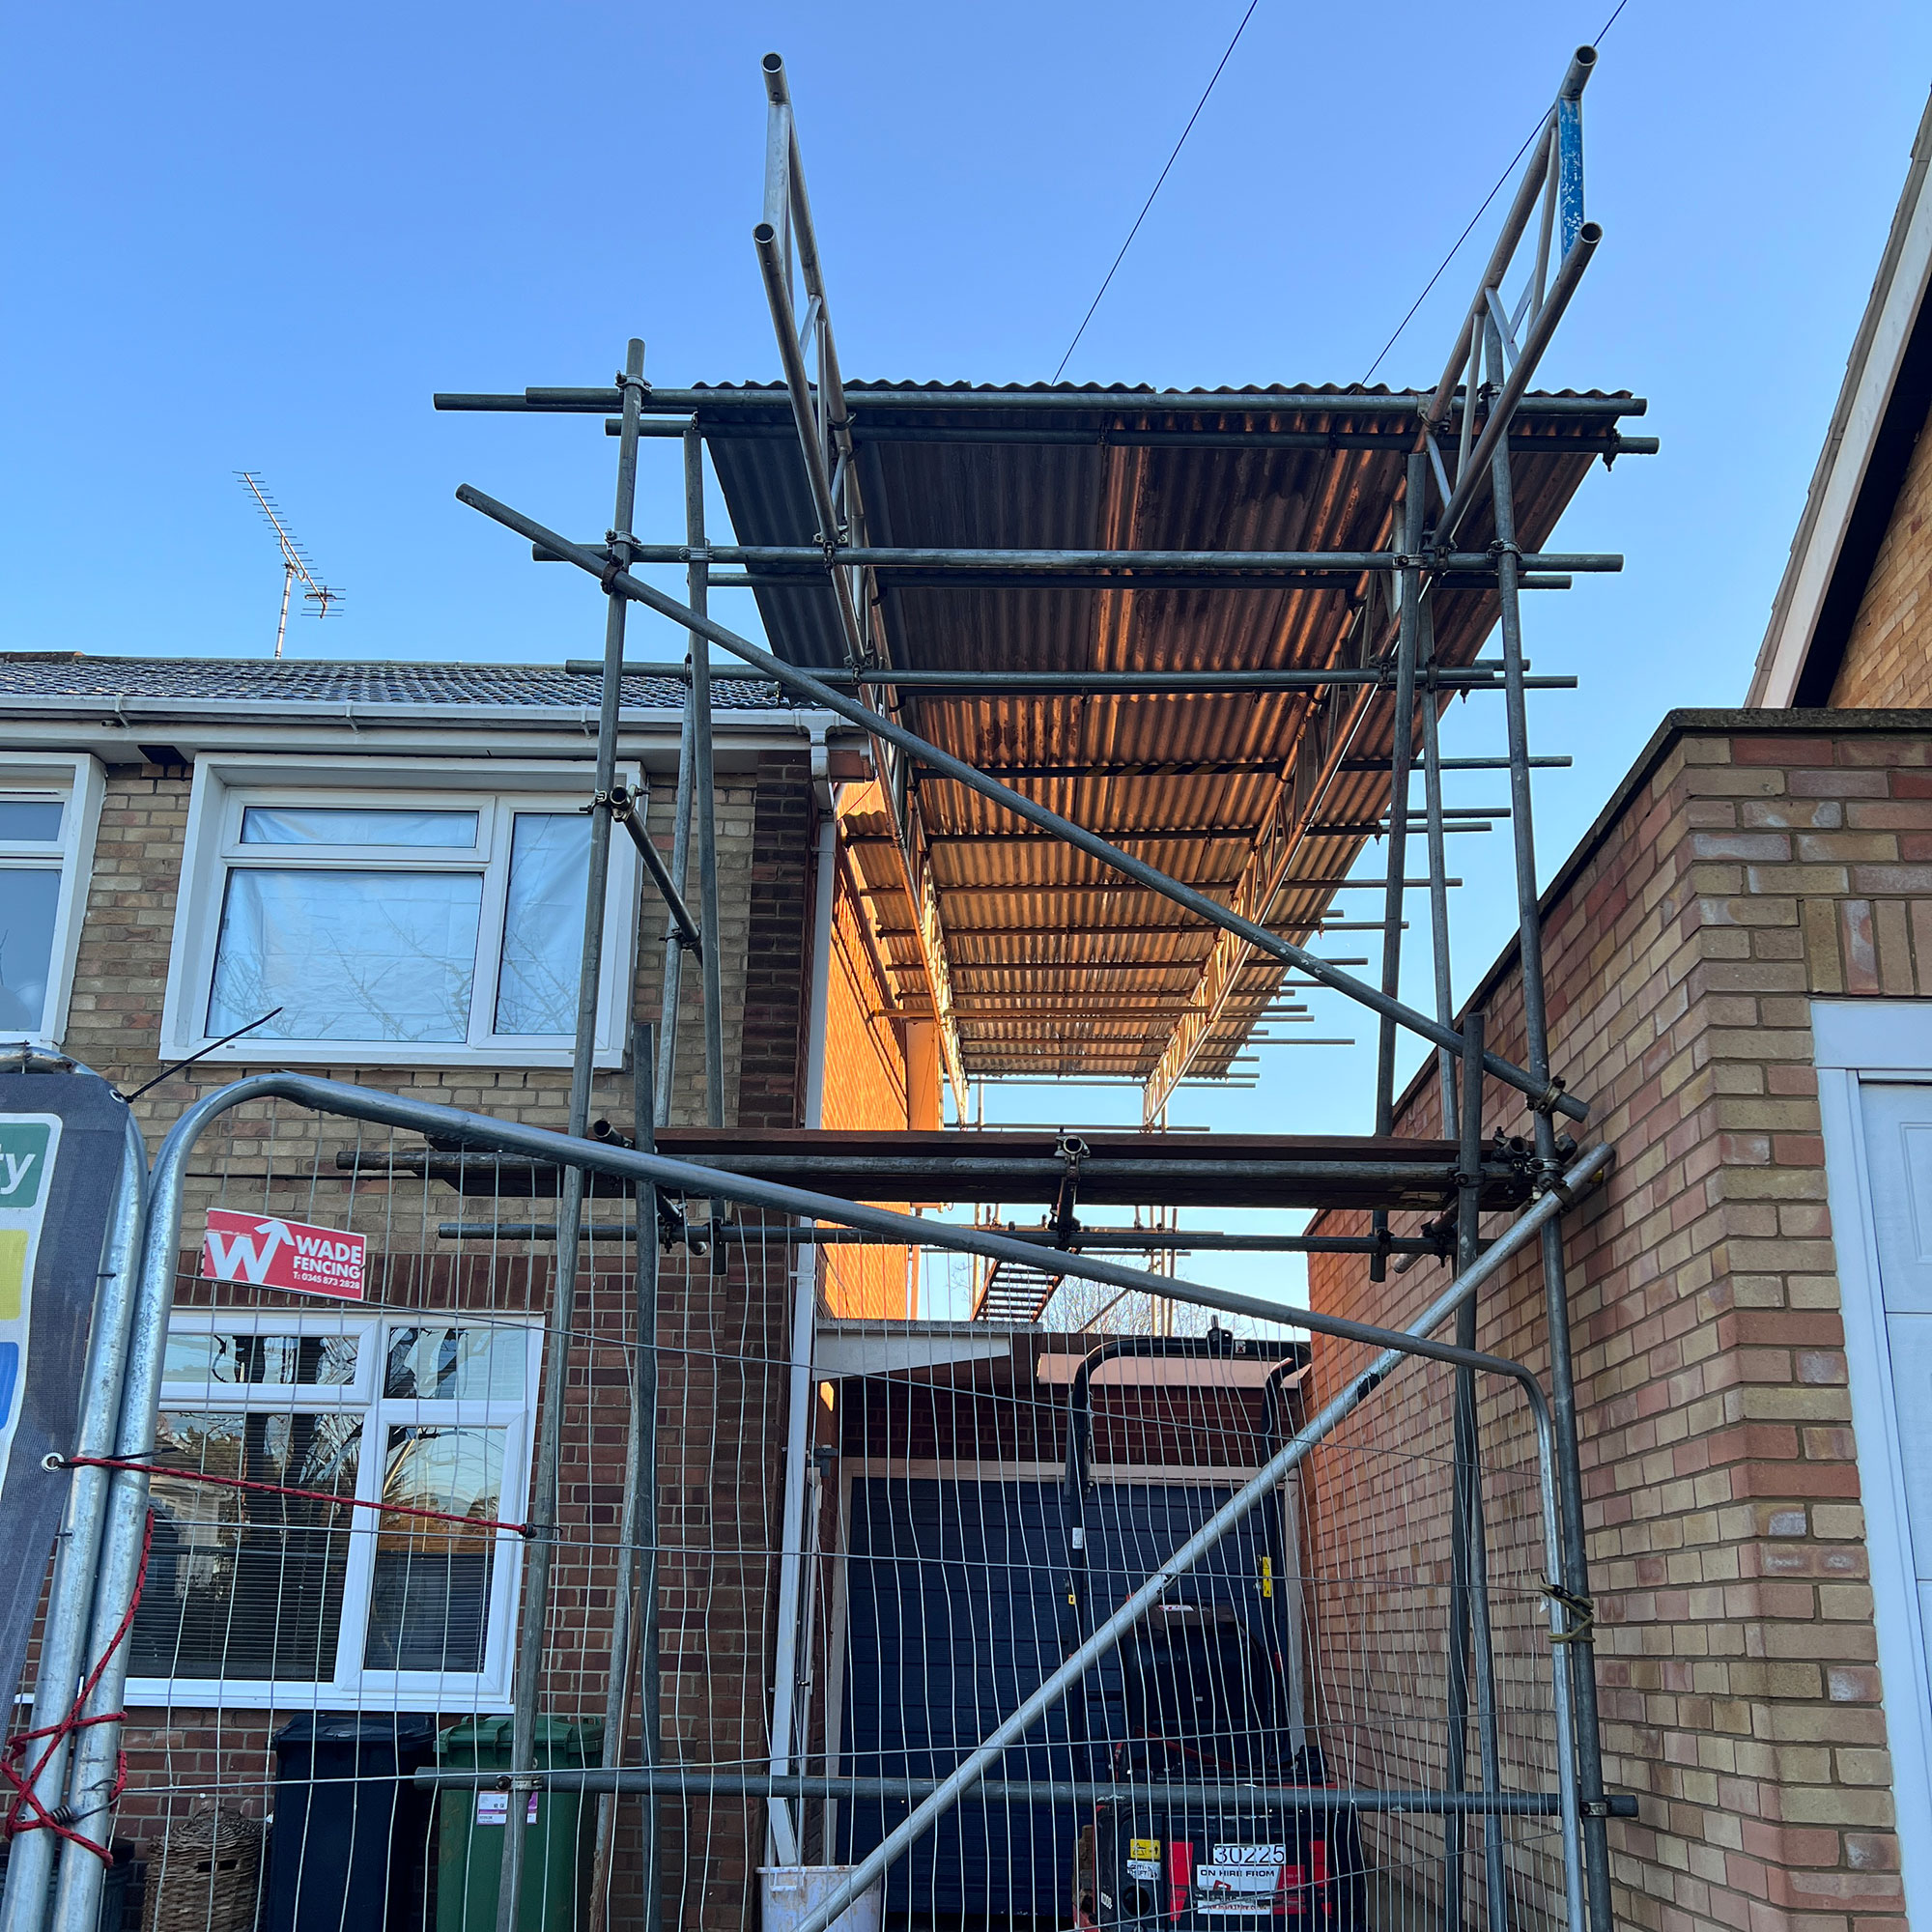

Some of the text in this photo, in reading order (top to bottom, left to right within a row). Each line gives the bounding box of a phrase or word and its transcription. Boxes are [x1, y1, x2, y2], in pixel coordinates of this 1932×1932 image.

[296, 1235, 362, 1265] WADE
[293, 1255, 361, 1280] FENCING
[301, 1272, 322, 1284] 0345
[323, 1276, 338, 1286] 873
[339, 1279, 360, 1290] 2828
[1214, 1844, 1286, 1864] 30225
